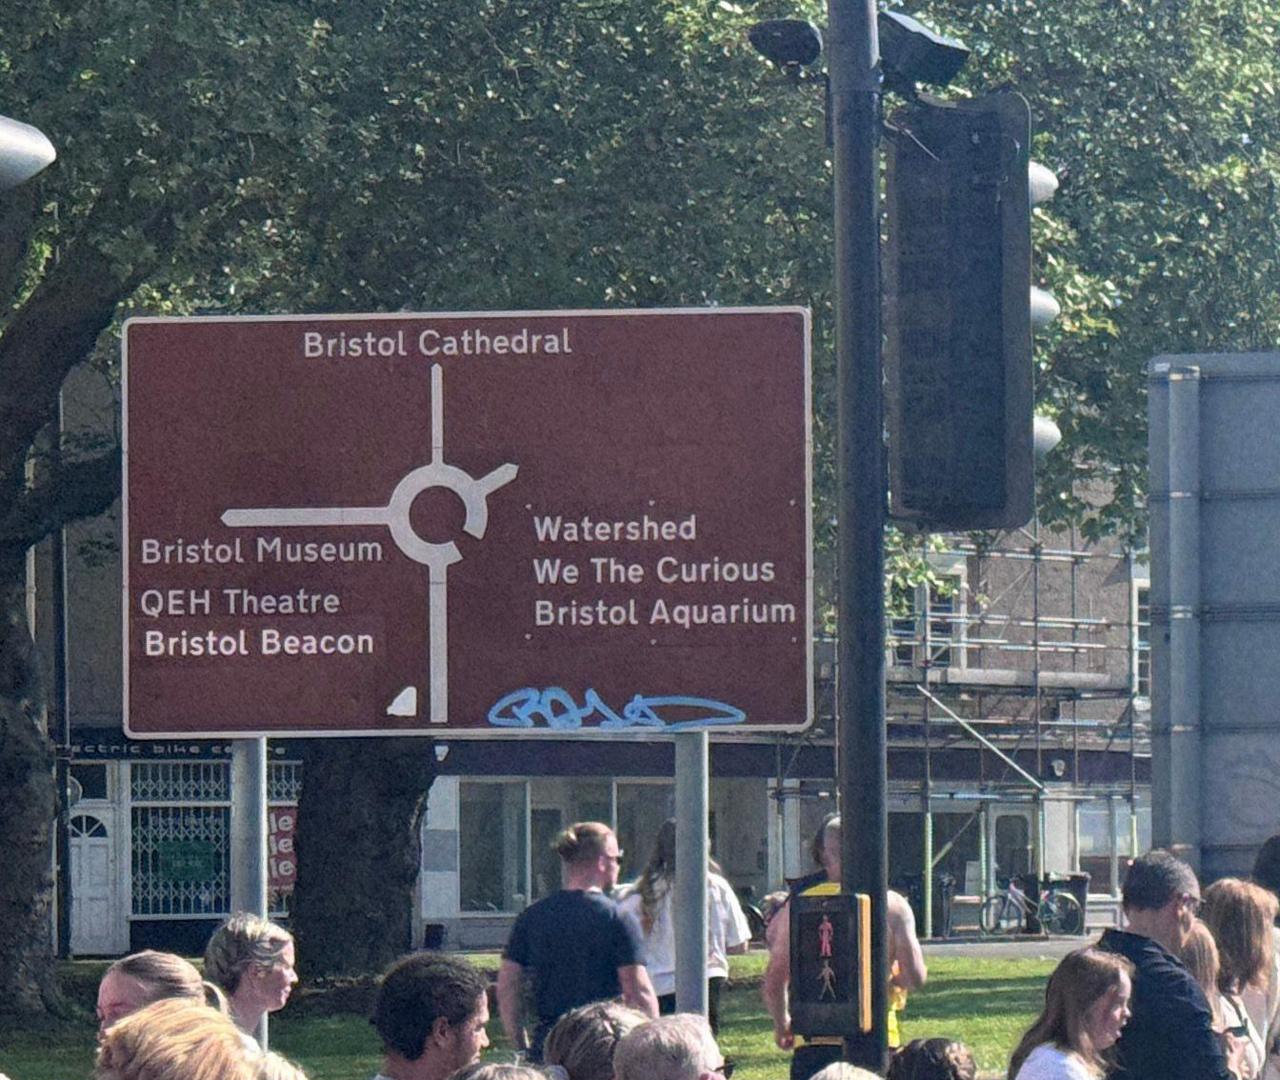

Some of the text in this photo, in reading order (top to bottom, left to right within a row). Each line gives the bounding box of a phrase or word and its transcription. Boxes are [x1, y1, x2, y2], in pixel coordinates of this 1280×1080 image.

[304, 327, 572, 358] Bristol Cathedral
[533, 514, 696, 543] Watershed
[142, 537, 383, 564] Bristol Museum
[533, 556, 775, 584] We The Curious
[141, 588, 340, 617] QEH Theatre
[535, 597, 796, 630] Bristol Aquarium
[145, 628, 374, 656] Bristol Beacon
[269, 812, 294, 833] le
[269, 836, 294, 855] le
[269, 858, 294, 878] le
